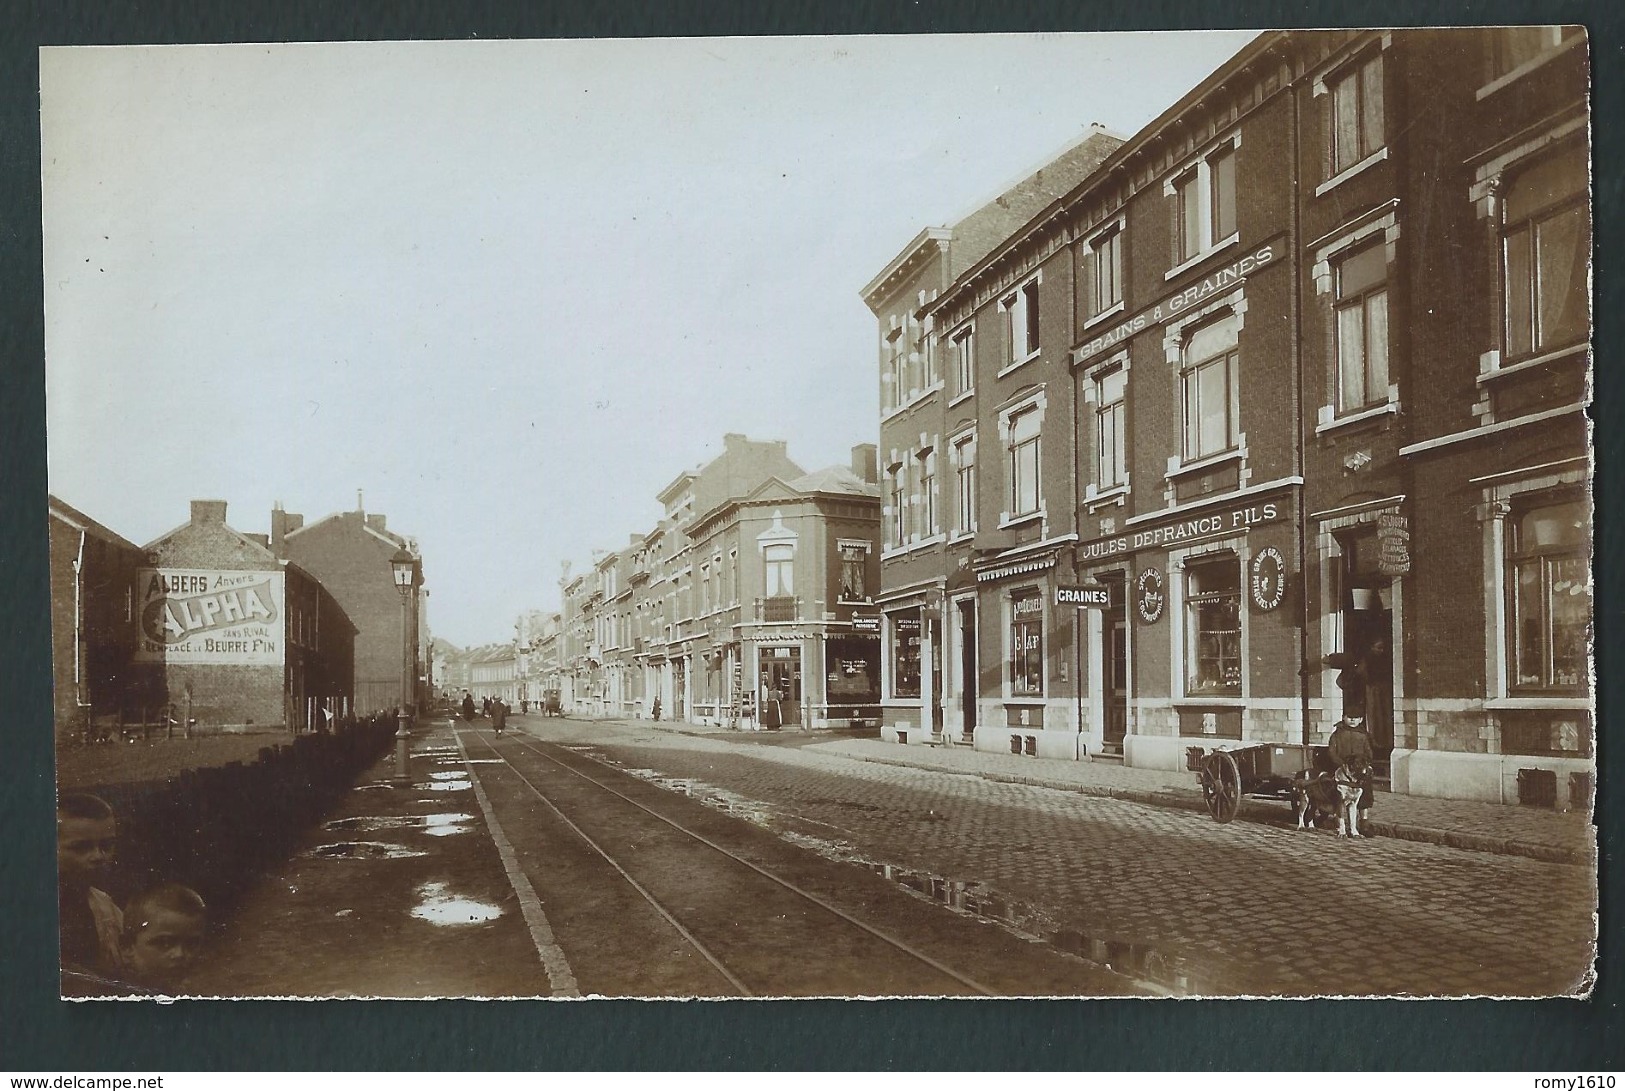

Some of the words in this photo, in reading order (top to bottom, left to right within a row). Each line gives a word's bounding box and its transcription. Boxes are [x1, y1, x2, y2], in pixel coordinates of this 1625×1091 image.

[1080, 314, 1145, 358] GRAINS
[1153, 305, 1162, 320] &
[1169, 245, 1273, 311] GRAINES
[1083, 536, 1127, 559] JULES
[1134, 515, 1222, 549] DEFRANCE
[1232, 503, 1277, 527] FILS
[145, 574, 207, 600] ALBERS
[213, 575, 254, 589] Anvers
[1057, 589, 1109, 604] GRAINES
[153, 588, 272, 638] ALPHA
[145, 641, 192, 653] REMPLACE
[205, 637, 248, 653] BEURRE
[252, 638, 275, 653] FIN
[223, 628, 242, 638] SANS
[243, 627, 270, 638] RIVAL
